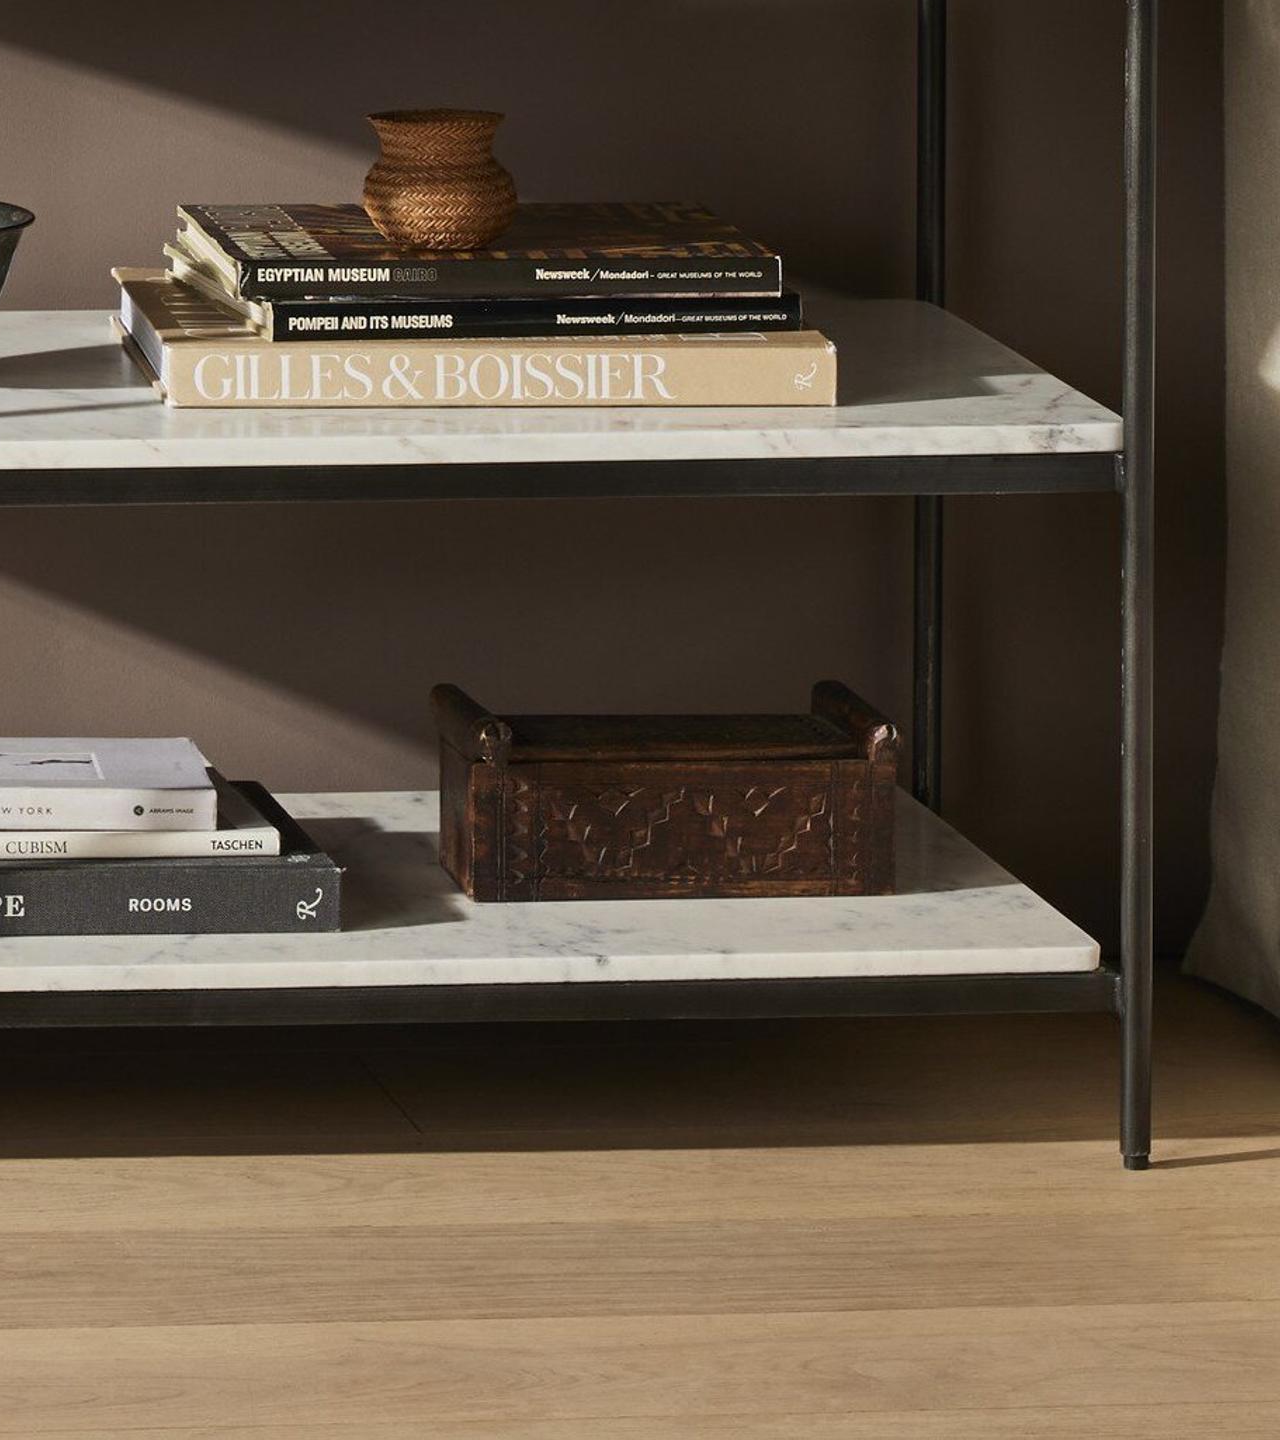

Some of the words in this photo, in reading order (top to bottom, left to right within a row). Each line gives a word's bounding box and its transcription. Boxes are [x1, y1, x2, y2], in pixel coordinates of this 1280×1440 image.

[257, 268, 324, 282] EGYPTIAN
[328, 268, 390, 282] MUSEUM
[392, 268, 437, 282] CAIRO
[656, 271, 678, 279] GREAT
[680, 271, 712, 279] MUSEUMS
[288, 317, 339, 331] POMPEII
[341, 316, 367, 330] AND
[370, 316, 389, 329] ITS
[391, 315, 454, 329] MUSEUMS
[681, 315, 704, 323] GREAT
[193, 353, 373, 401] GILLES
[381, 353, 423, 401] &
[433, 353, 677, 401] BOISSIER
[20, 806, 53, 815] YORK
[5, 840, 68, 854] CUBISM
[211, 839, 263, 851] TASCHEN
[129, 897, 192, 914] ROOMS
